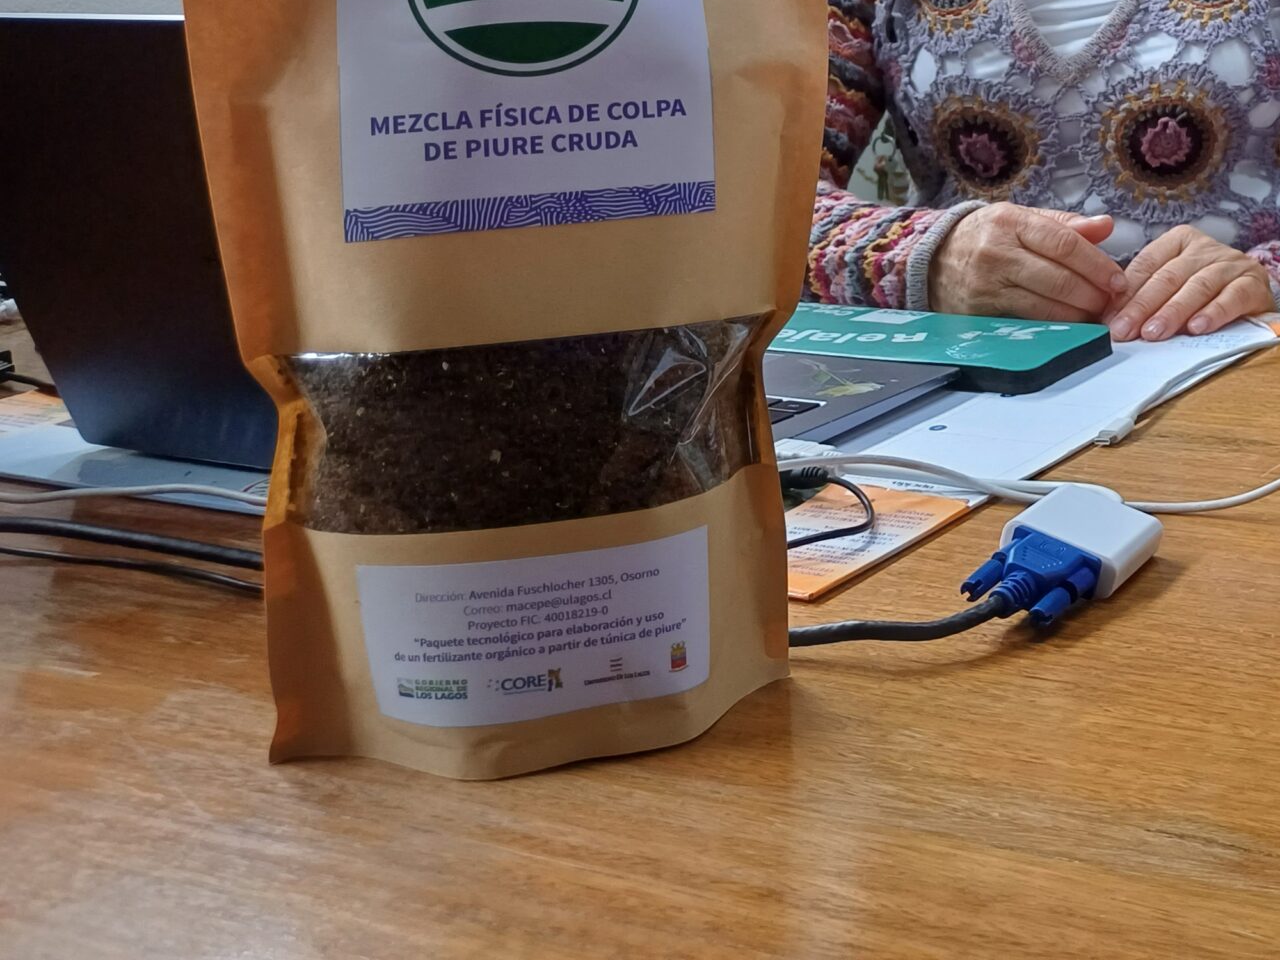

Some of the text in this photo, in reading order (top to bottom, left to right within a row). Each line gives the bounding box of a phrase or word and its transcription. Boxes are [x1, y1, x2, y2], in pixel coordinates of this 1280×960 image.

[370, 98, 687, 136] MEZCLA FÍSICA DE COLPA
[423, 129, 639, 162] DE PIURE CRUDA
[415, 567, 660, 603] Dirección: Avenida Fuschlocher 1305, Osorno
[463, 589, 613, 617] Correo: macepe@ulagos.cl
[467, 617, 518, 633] Proyecto
[544, 605, 609, 624] 40018219-0
[467, 629, 534, 649] tecnológico
[537, 628, 564, 643] para
[566, 616, 634, 636] elaboración
[635, 616, 643, 628] y
[645, 612, 665, 623] uso
[394, 651, 406, 663] de
[408, 653, 421, 664] un
[422, 650, 483, 664] fertilizante
[485, 645, 536, 662] orgánico
[548, 638, 581, 655] partir
[583, 636, 599, 648] de
[600, 628, 636, 646] túnica
[639, 626, 652, 640] de
[414, 678, 468, 686] GOBIERNO
[415, 692, 468, 701] LOS LAGOS
[501, 674, 547, 692] CORE
